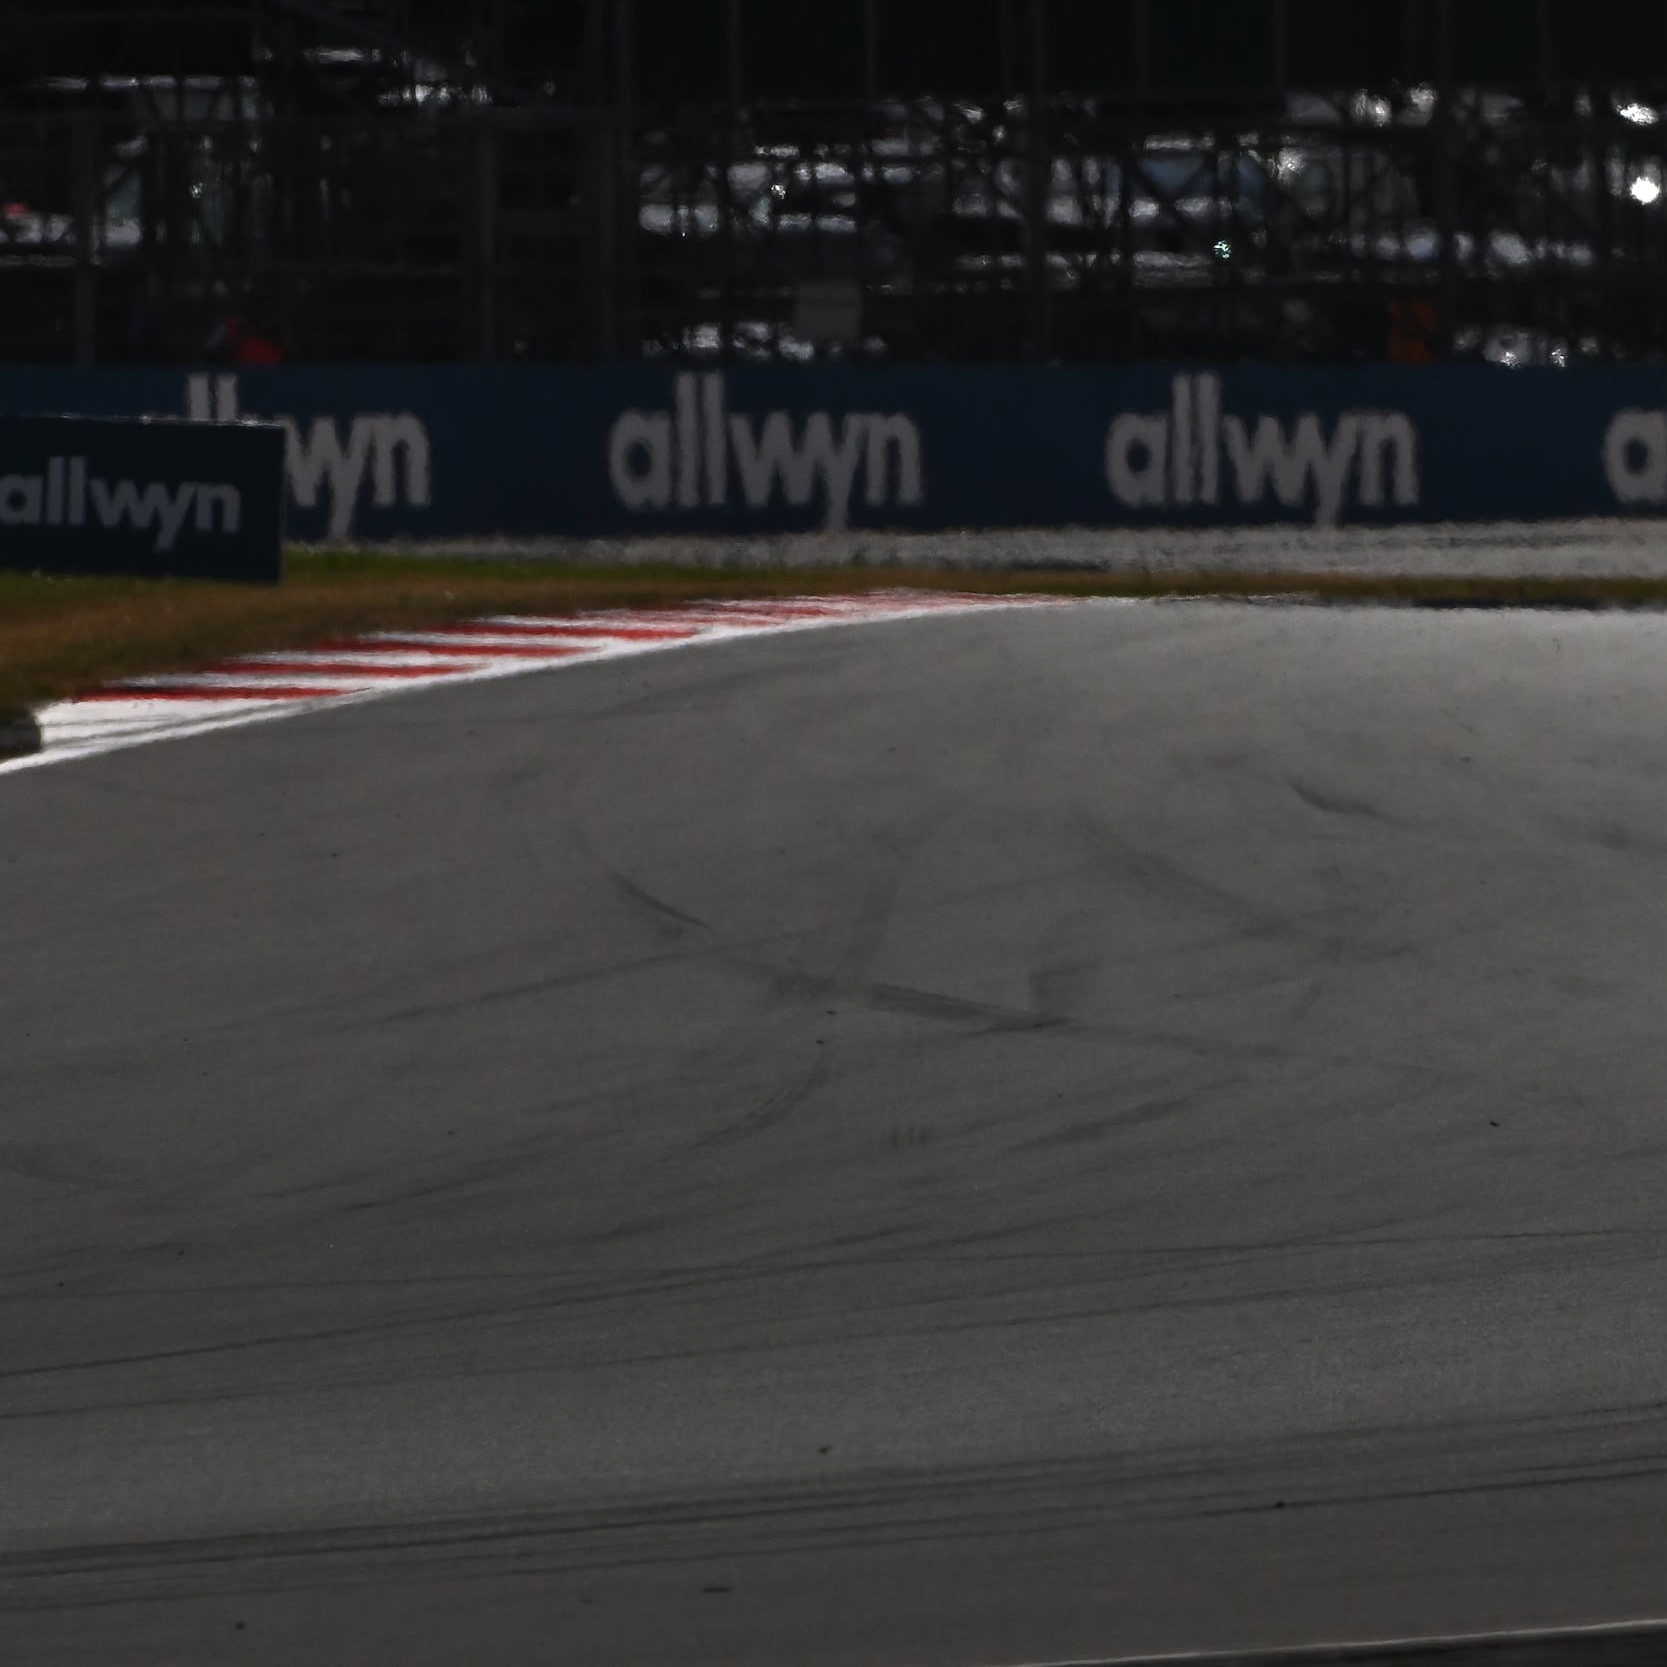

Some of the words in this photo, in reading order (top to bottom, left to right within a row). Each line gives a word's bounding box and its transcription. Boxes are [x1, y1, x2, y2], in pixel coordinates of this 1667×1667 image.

[0, 454, 241, 553] allwyn
[609, 370, 924, 530] allwyn
[1104, 370, 1420, 528] allwyn
